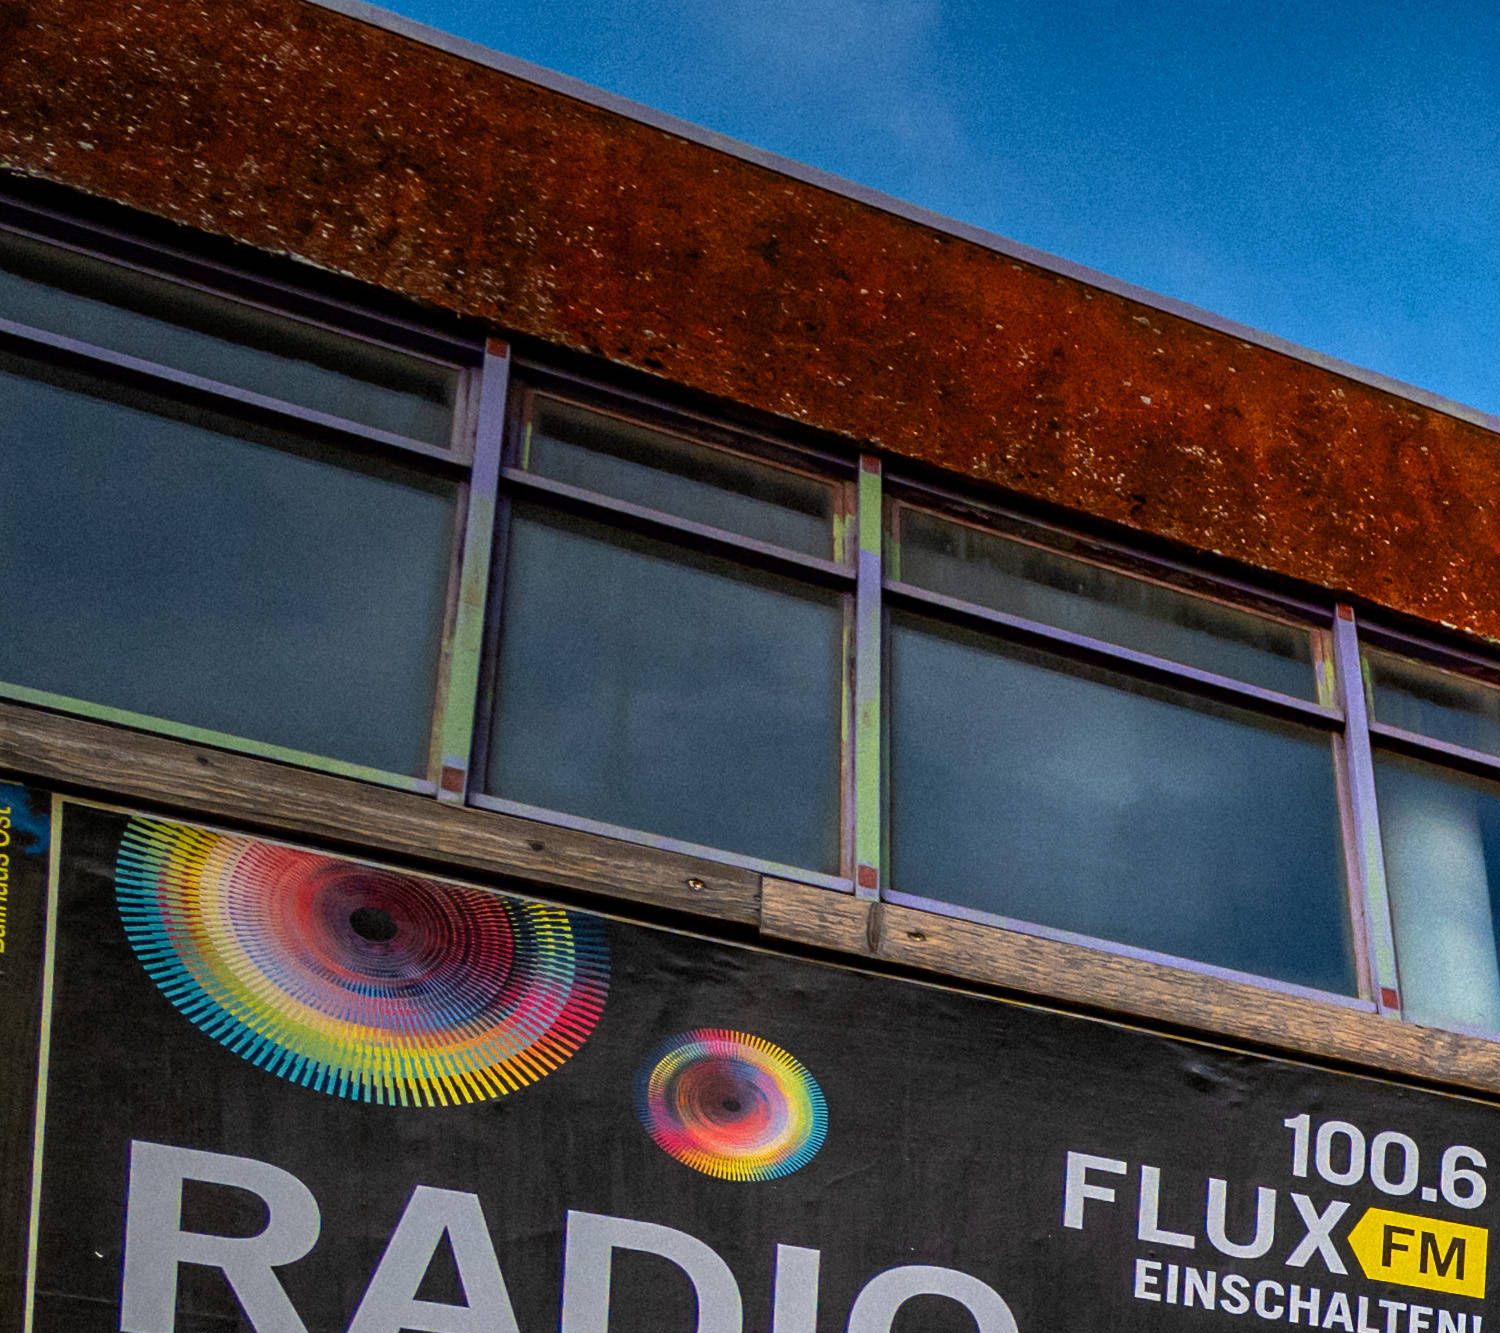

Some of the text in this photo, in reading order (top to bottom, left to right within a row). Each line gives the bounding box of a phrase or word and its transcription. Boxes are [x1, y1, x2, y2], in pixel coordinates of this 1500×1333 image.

[1062, 1150, 1469, 1281] FLUX FM
[1285, 1112, 1490, 1209] 100.6
